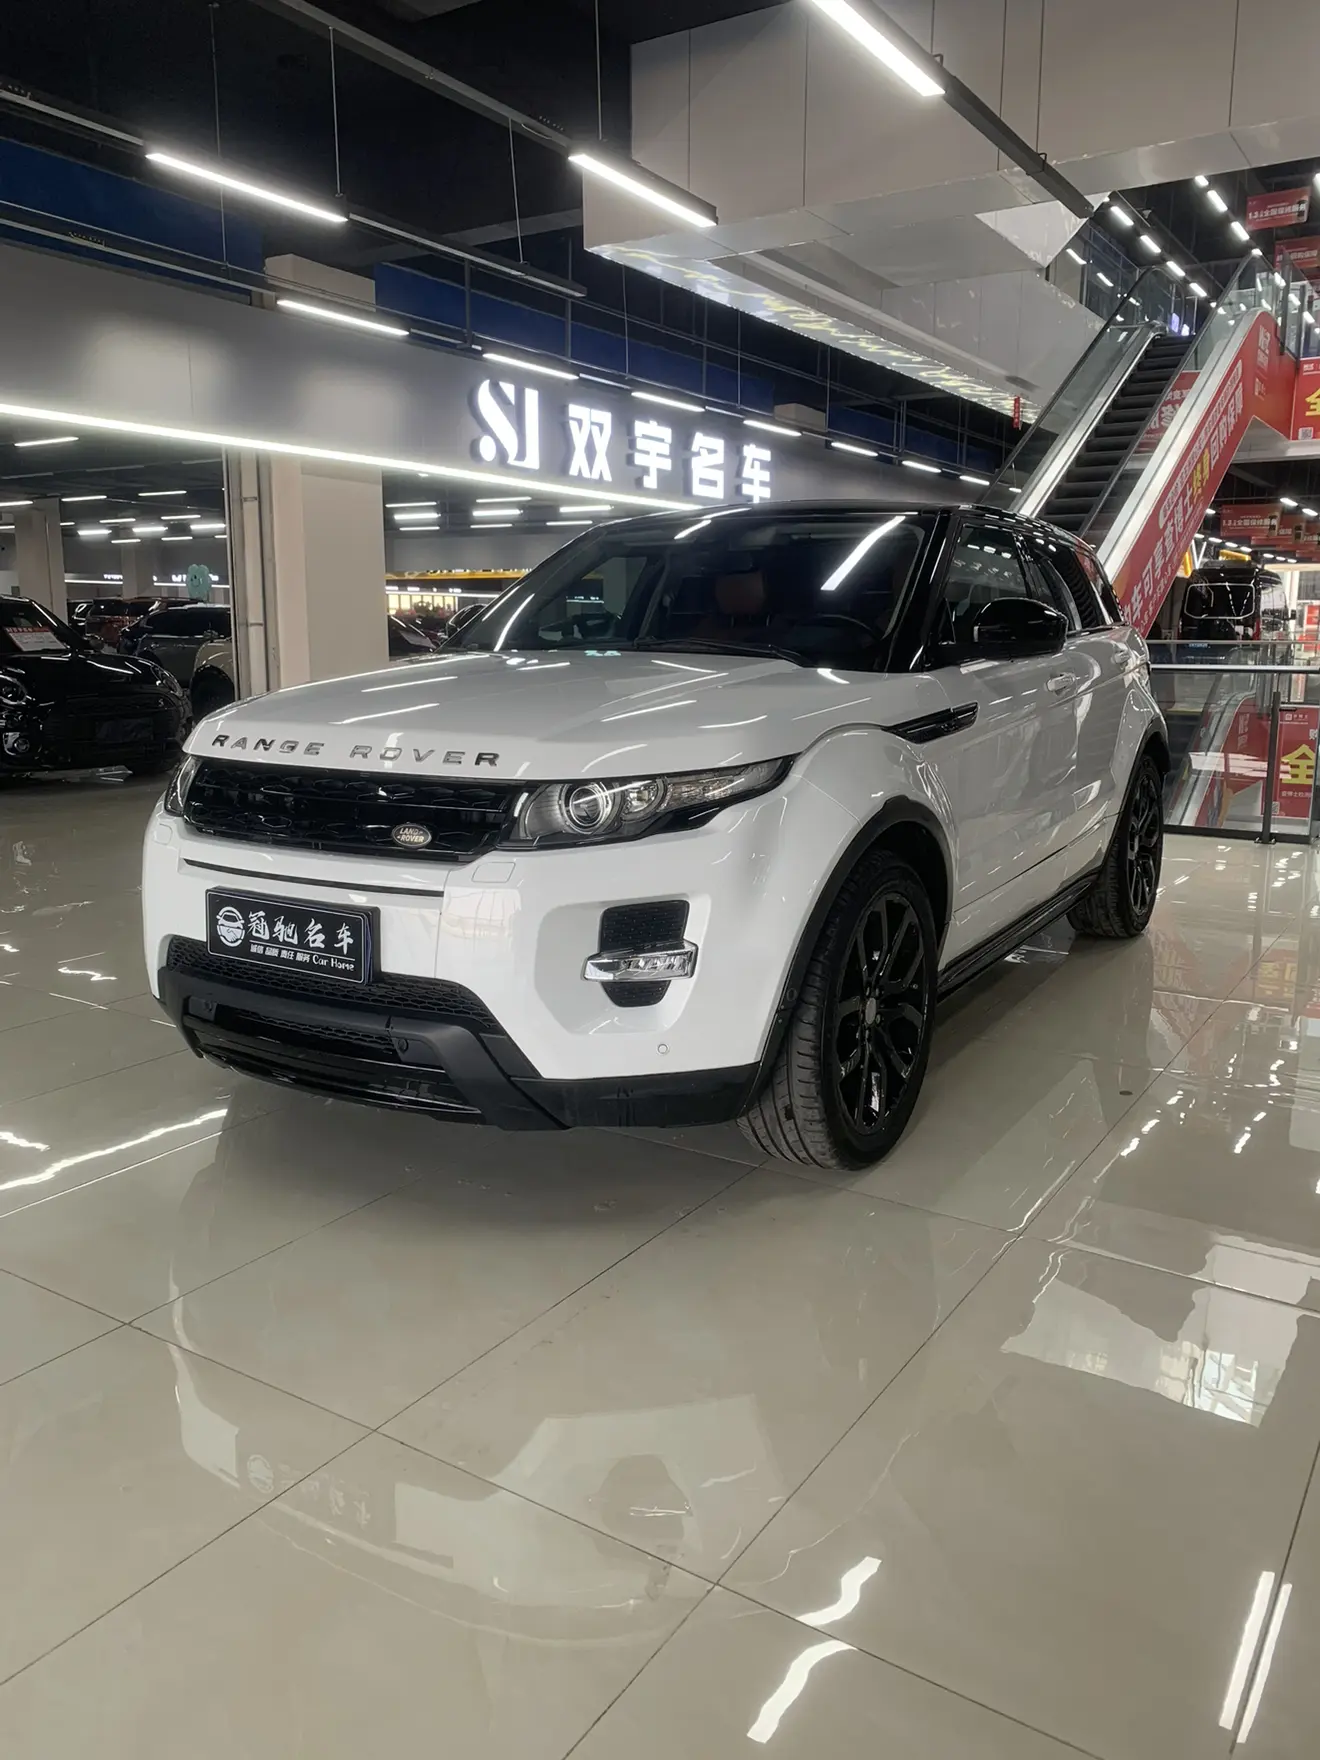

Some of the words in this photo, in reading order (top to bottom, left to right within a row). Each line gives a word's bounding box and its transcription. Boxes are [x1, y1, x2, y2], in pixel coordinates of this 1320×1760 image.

[567, 403, 772, 503] 双宇名车
[211, 734, 325, 756] RANGE
[349, 745, 500, 767] ROVER
[400, 834, 425, 843] ROVER
[248, 910, 354, 955] 冠驰名车
[312, 954, 329, 966] Car
